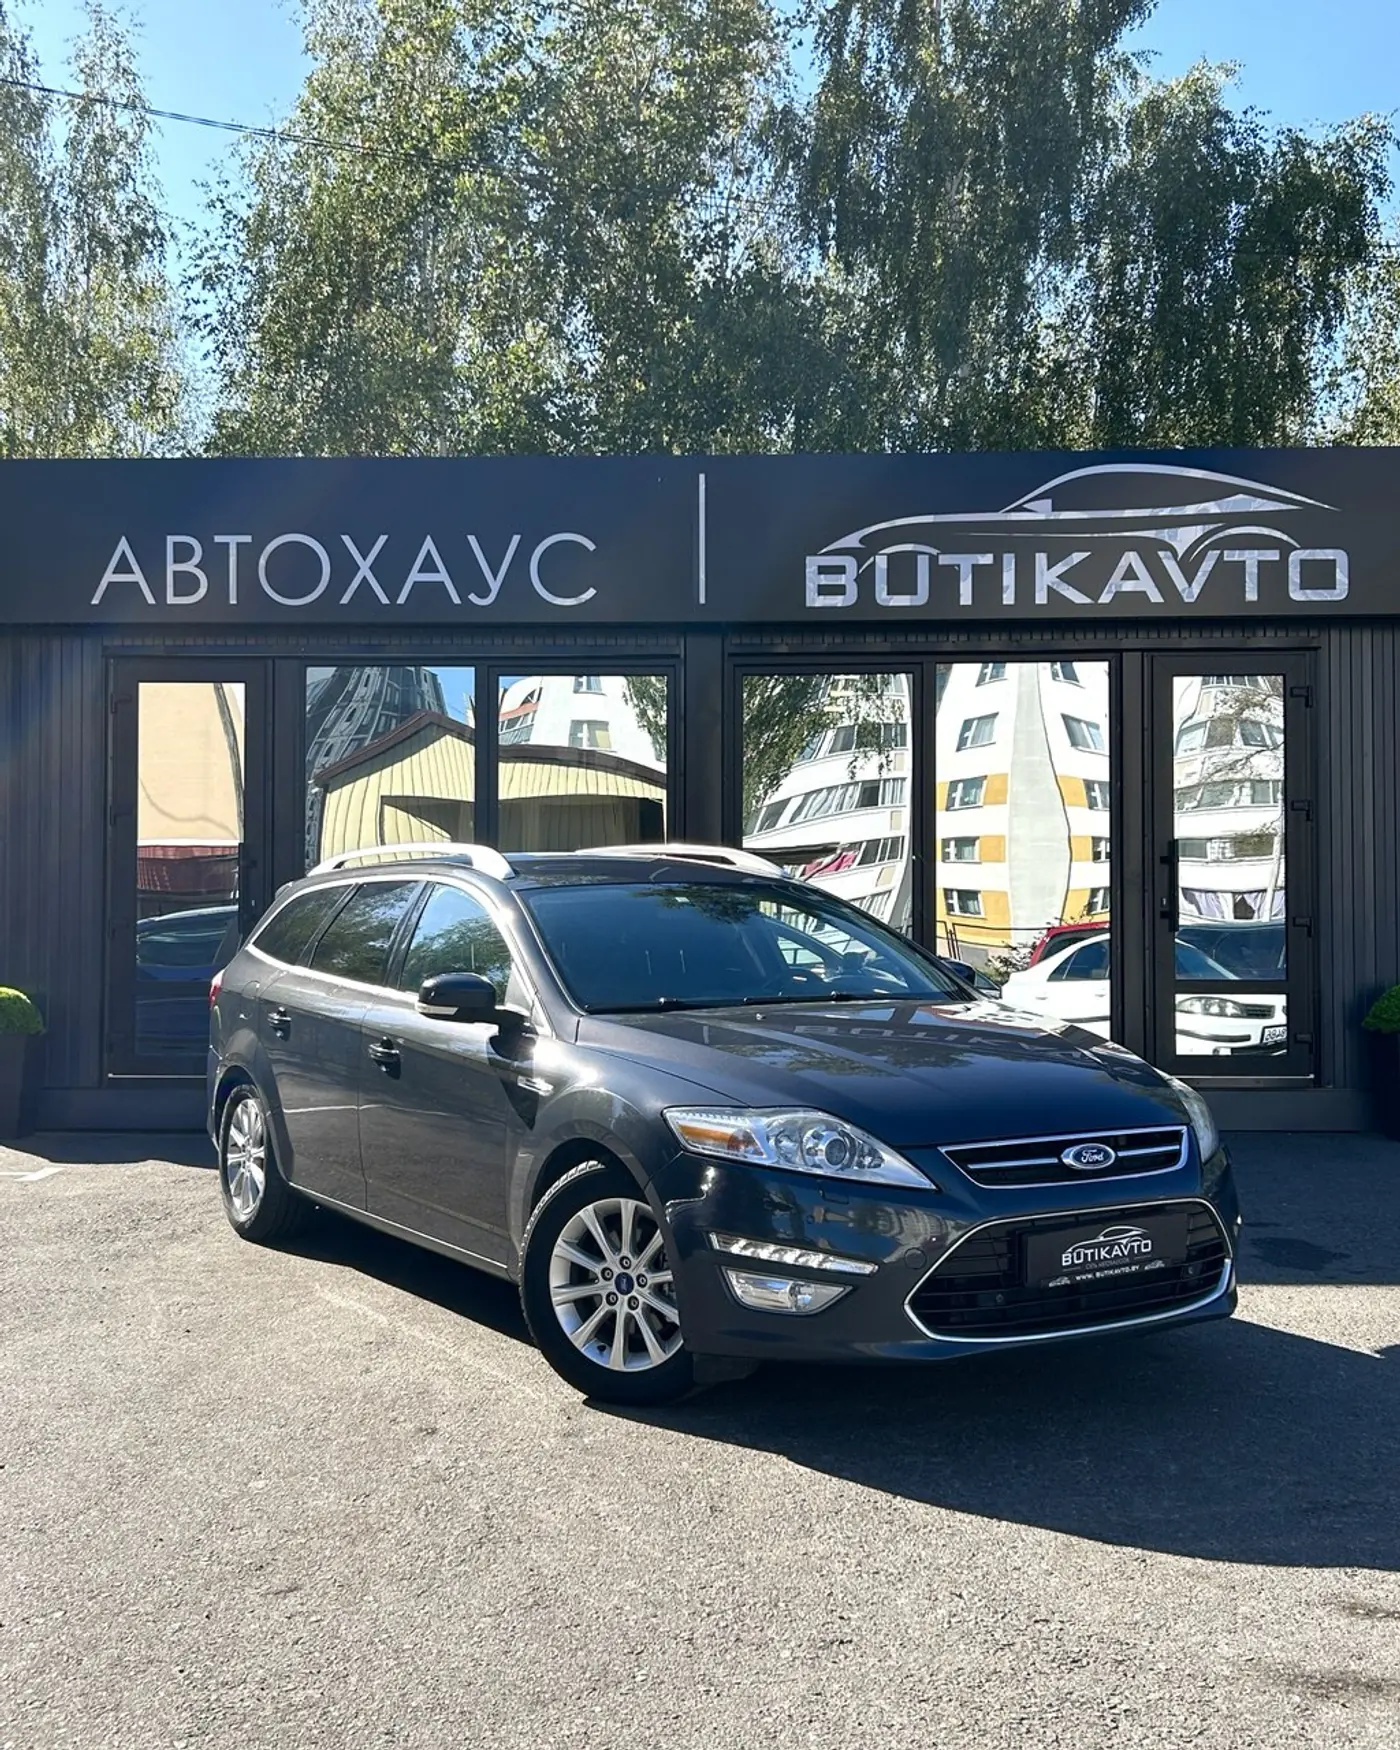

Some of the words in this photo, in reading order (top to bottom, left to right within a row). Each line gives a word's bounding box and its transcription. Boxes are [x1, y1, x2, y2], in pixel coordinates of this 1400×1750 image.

[91, 532, 597, 606] АВТОХАУС
[805, 548, 1349, 607] BUTIKAVTO
[1081, 1149, 1105, 1163] Ford
[1061, 1239, 1152, 1266] BUTIKAVTO
